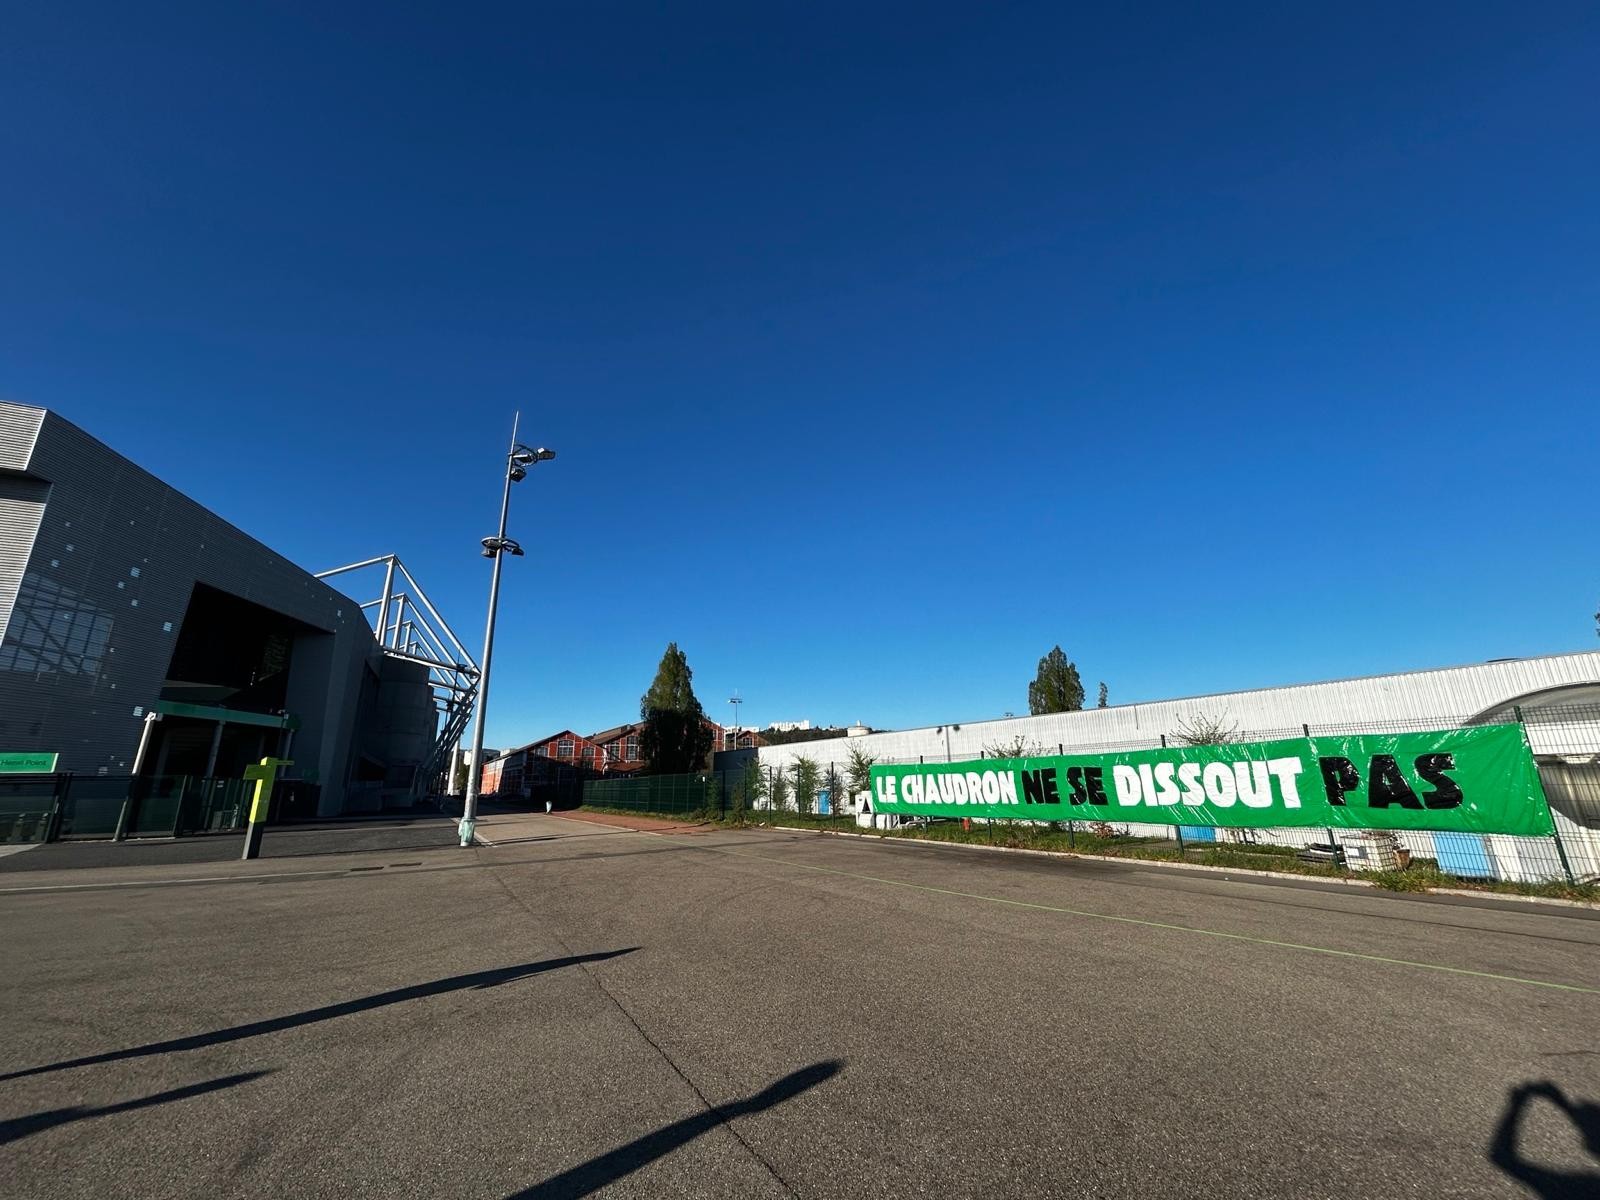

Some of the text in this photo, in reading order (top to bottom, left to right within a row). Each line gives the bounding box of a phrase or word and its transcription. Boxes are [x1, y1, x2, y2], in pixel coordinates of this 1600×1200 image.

[876, 752, 1464, 810] LE CHAUDRON NE SE DISSOUT PAS
